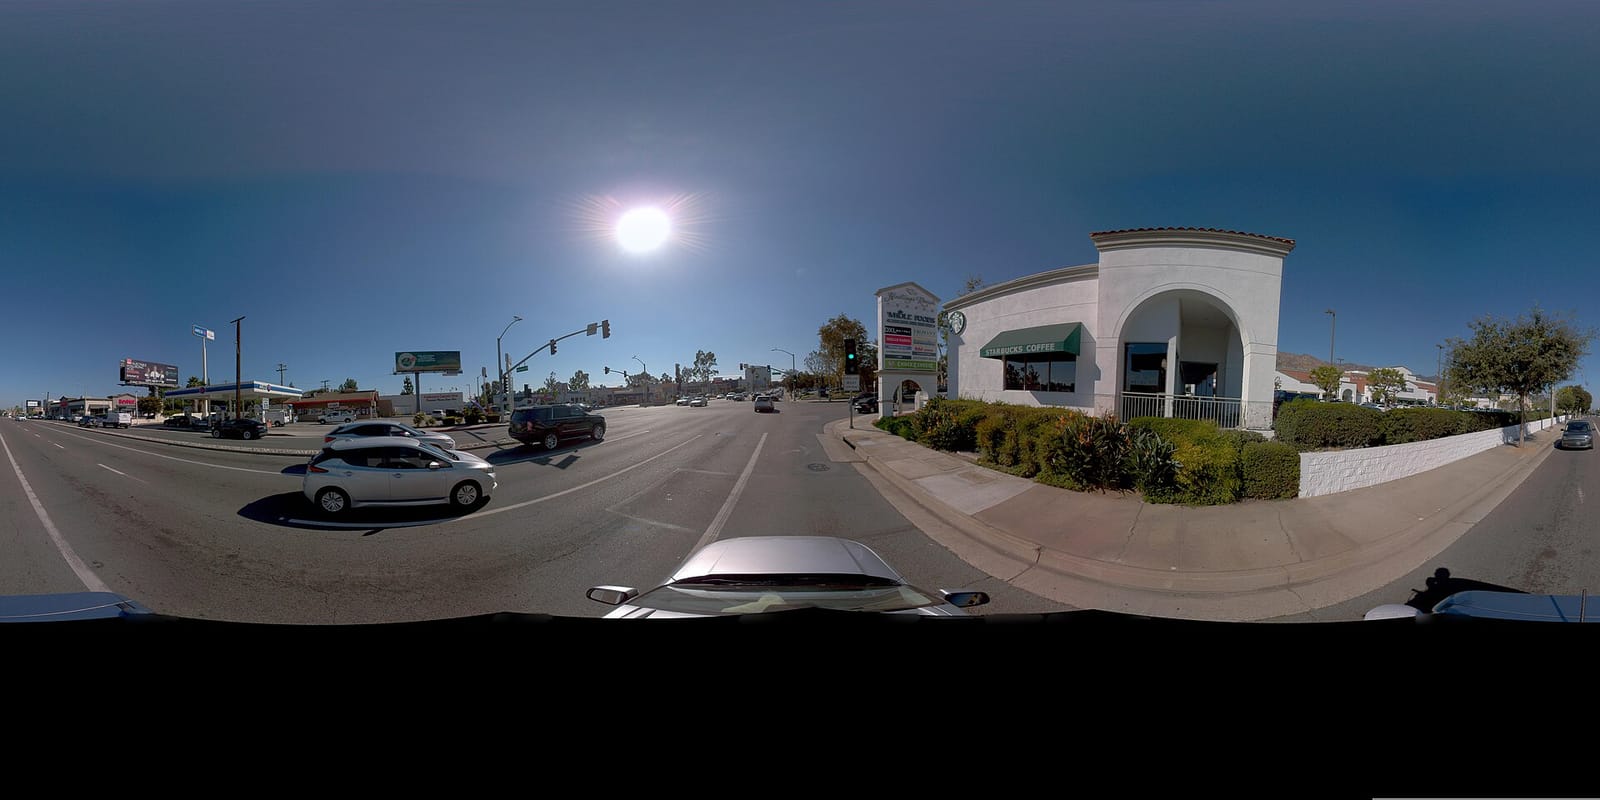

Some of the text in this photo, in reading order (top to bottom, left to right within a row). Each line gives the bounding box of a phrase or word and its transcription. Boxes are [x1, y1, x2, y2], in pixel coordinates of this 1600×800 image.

[887, 311, 913, 321] WHOLE
[986, 343, 1055, 356] STARBUCKS COFFEE
